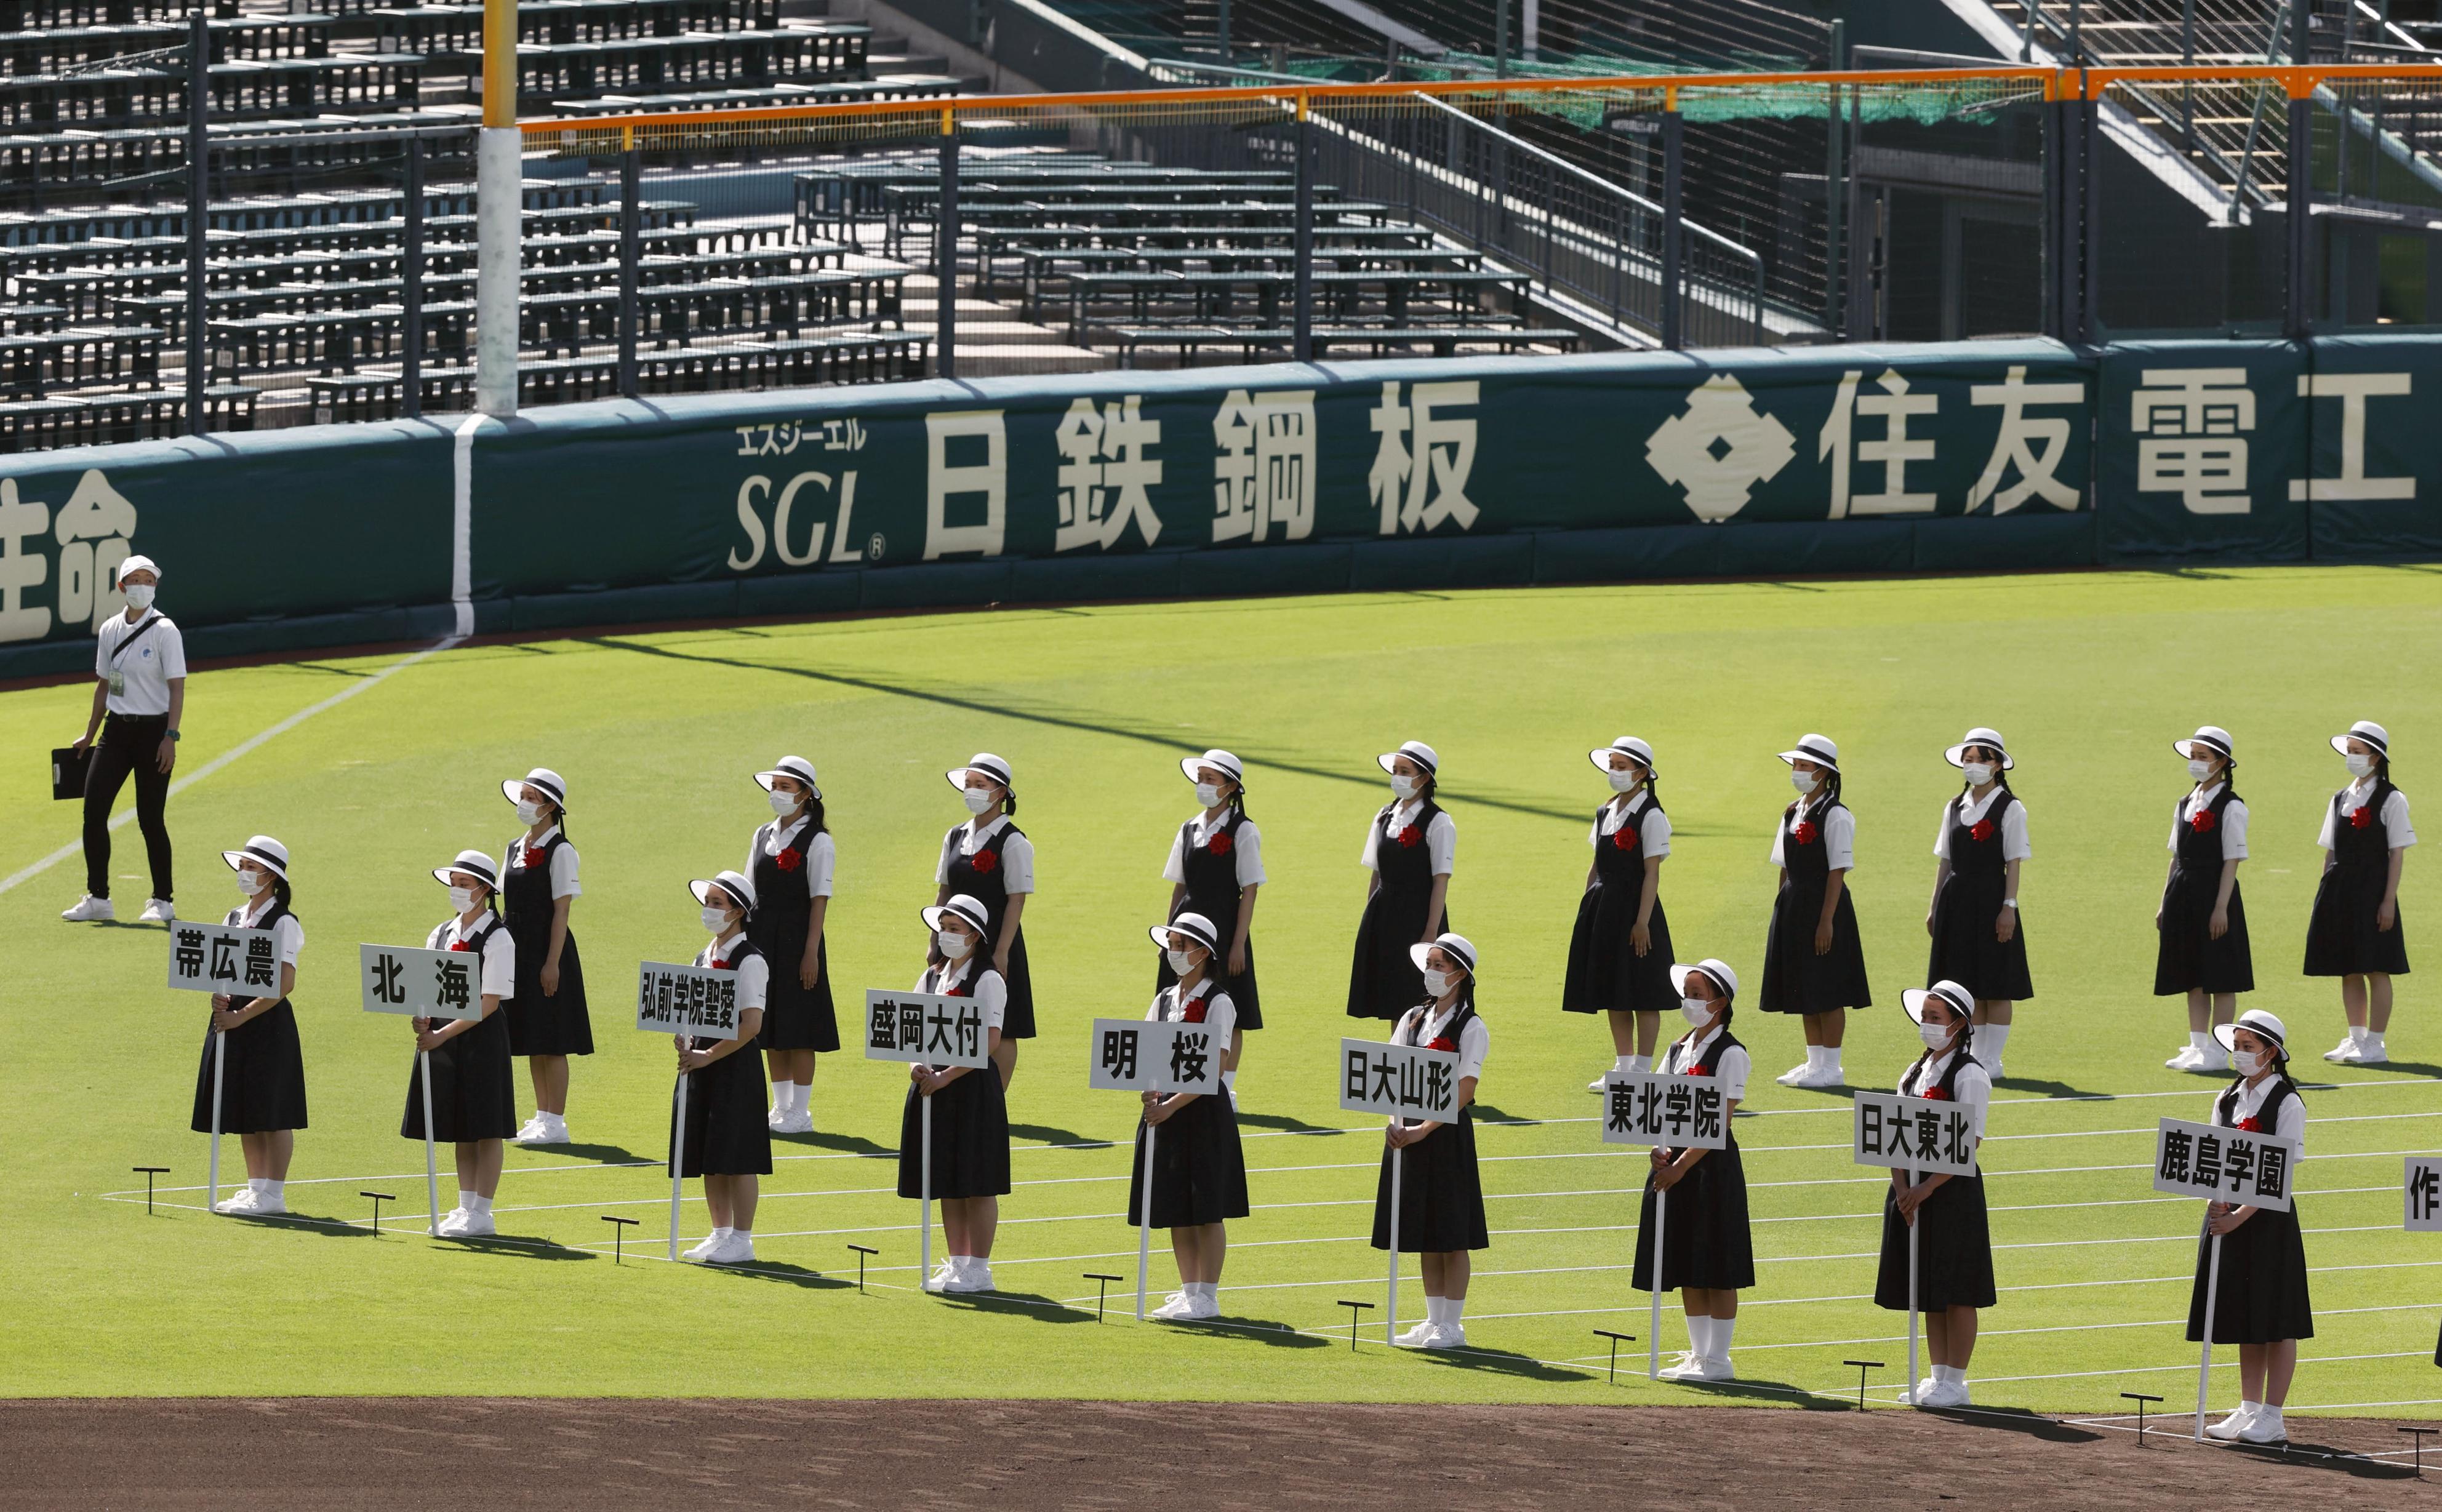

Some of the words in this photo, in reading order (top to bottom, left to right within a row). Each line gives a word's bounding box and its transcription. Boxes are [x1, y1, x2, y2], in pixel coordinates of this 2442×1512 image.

[736, 417, 867, 457] エスジーエル
[1819, 366, 2417, 520] 住友電工
[923, 380, 1480, 560] 日鉄鋼板
[176, 929, 274, 988] 帯広農
[372, 954, 470, 1009] 北海
[641, 971, 735, 1030] 弘前学院聖愛
[870, 999, 982, 1058] 盛岡大付
[1102, 1030, 1209, 1083] 明桜
[1347, 1049, 1452, 1112] 日大山形
[1609, 1080, 1721, 1138] 東北学院
[1862, 1103, 1969, 1165] 日大東北
[2160, 1129, 2288, 1200] 鹿島学園
[2410, 1165, 2440, 1220] 作
